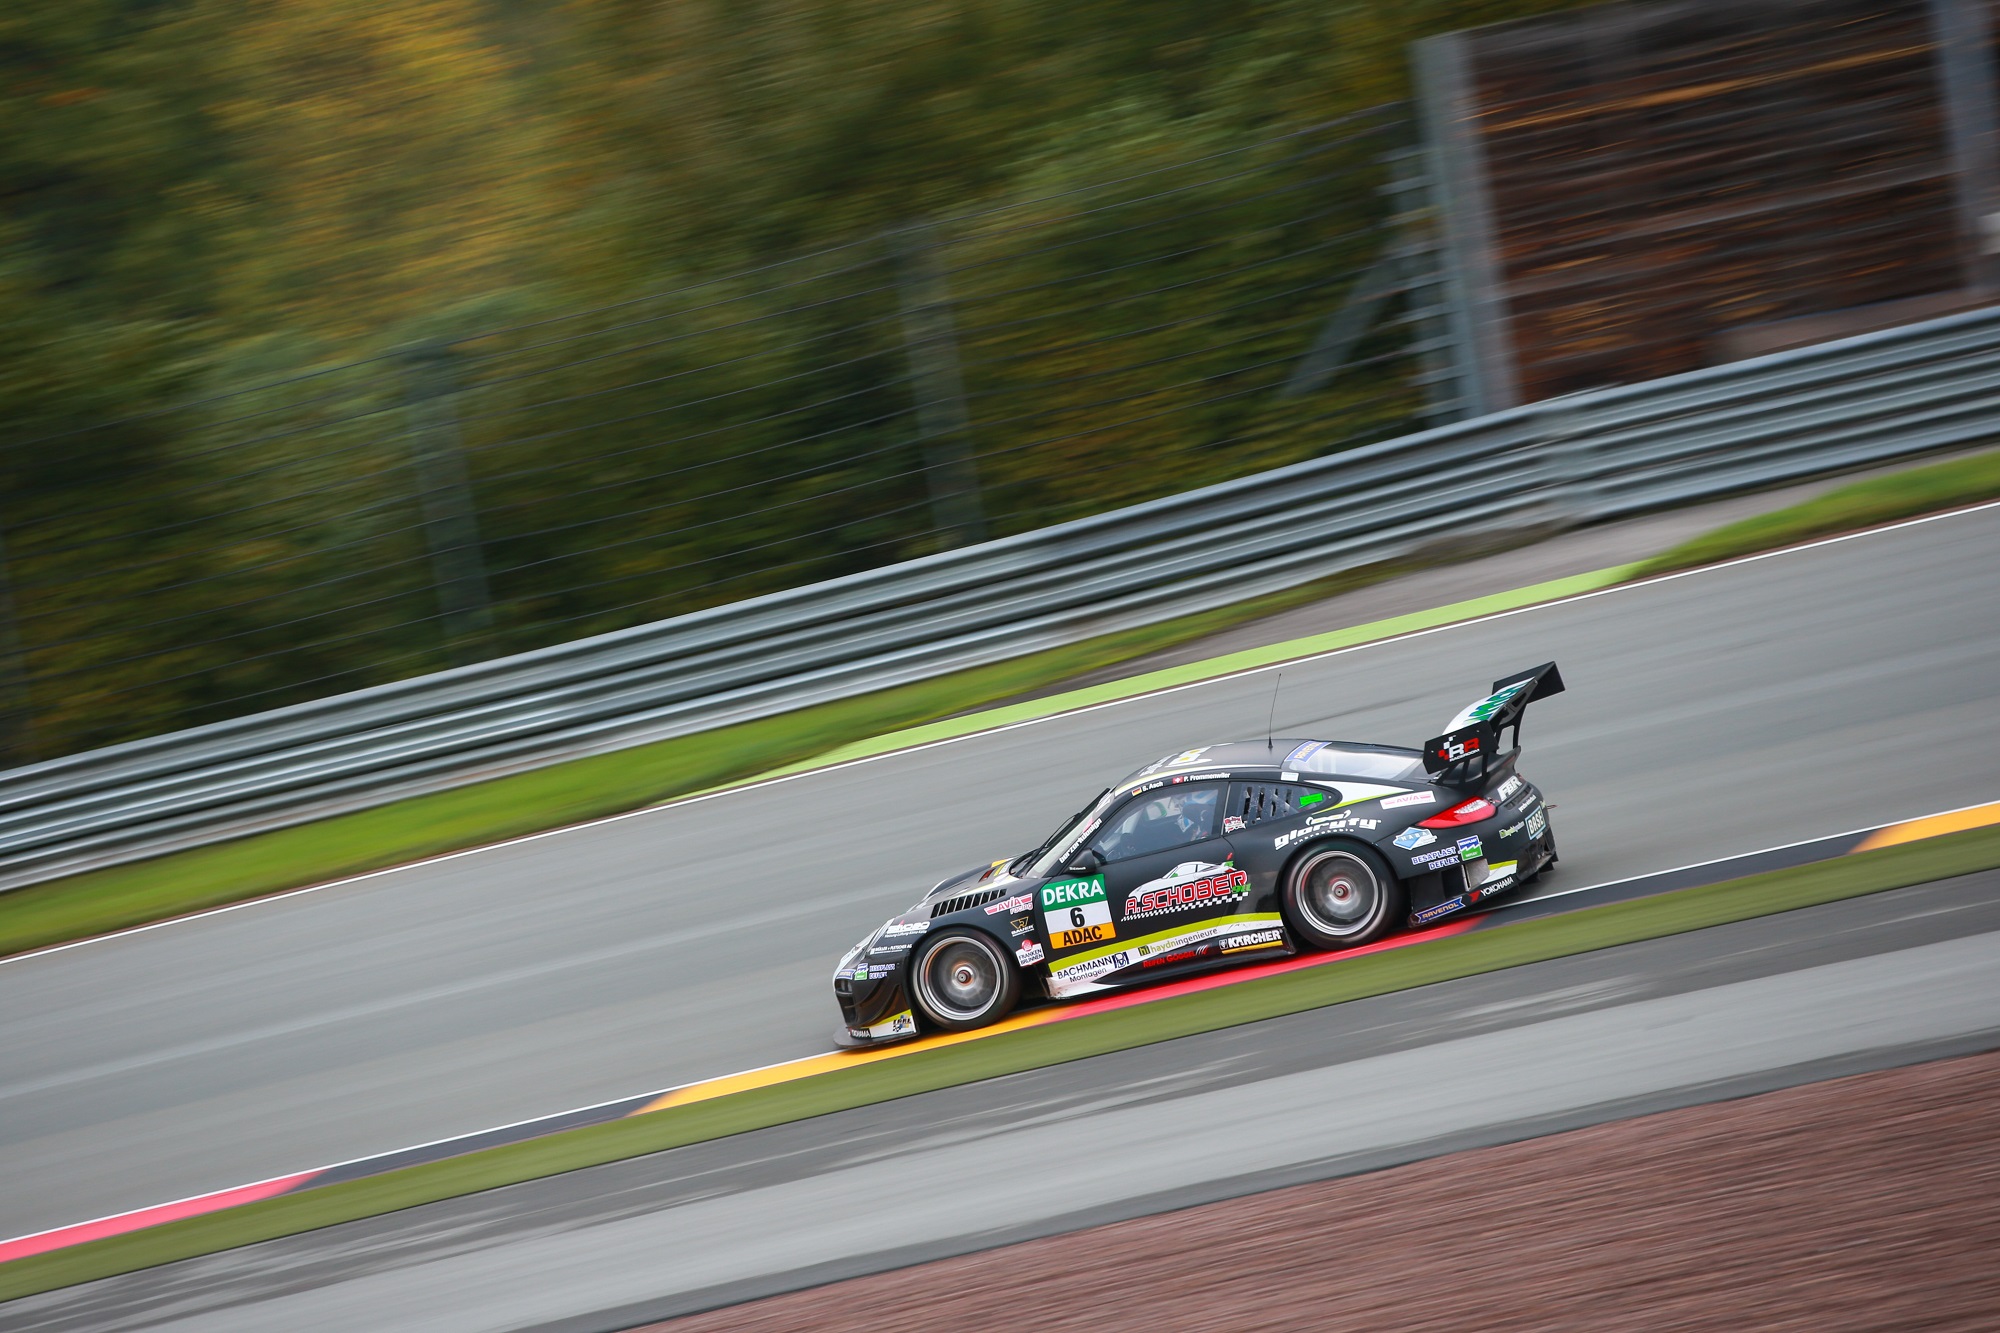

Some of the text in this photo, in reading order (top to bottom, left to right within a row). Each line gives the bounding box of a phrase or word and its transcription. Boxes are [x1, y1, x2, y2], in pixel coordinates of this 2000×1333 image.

[1396, 794, 1420, 804] AVIA
[1411, 846, 1456, 865] BESAPLAST
[1428, 855, 1460, 870] DEFLEX
[1042, 879, 1104, 906] DEKRA
[1480, 876, 1514, 896] YOKOHAMA
[998, 897, 1020, 911] AVIA
[1422, 902, 1459, 919] RAVENOL
[1070, 907, 1085, 928] 6
[1063, 926, 1102, 946] ADAC
[1150, 928, 1218, 953] haydningenieure
[1228, 930, 1282, 948] KÄRCHER
[1019, 948, 1042, 960] FRANKEN
[1020, 953, 1044, 965] BRUNNEN
[1057, 956, 1112, 980] BACHMANN
[1069, 967, 1107, 983] Montagen
